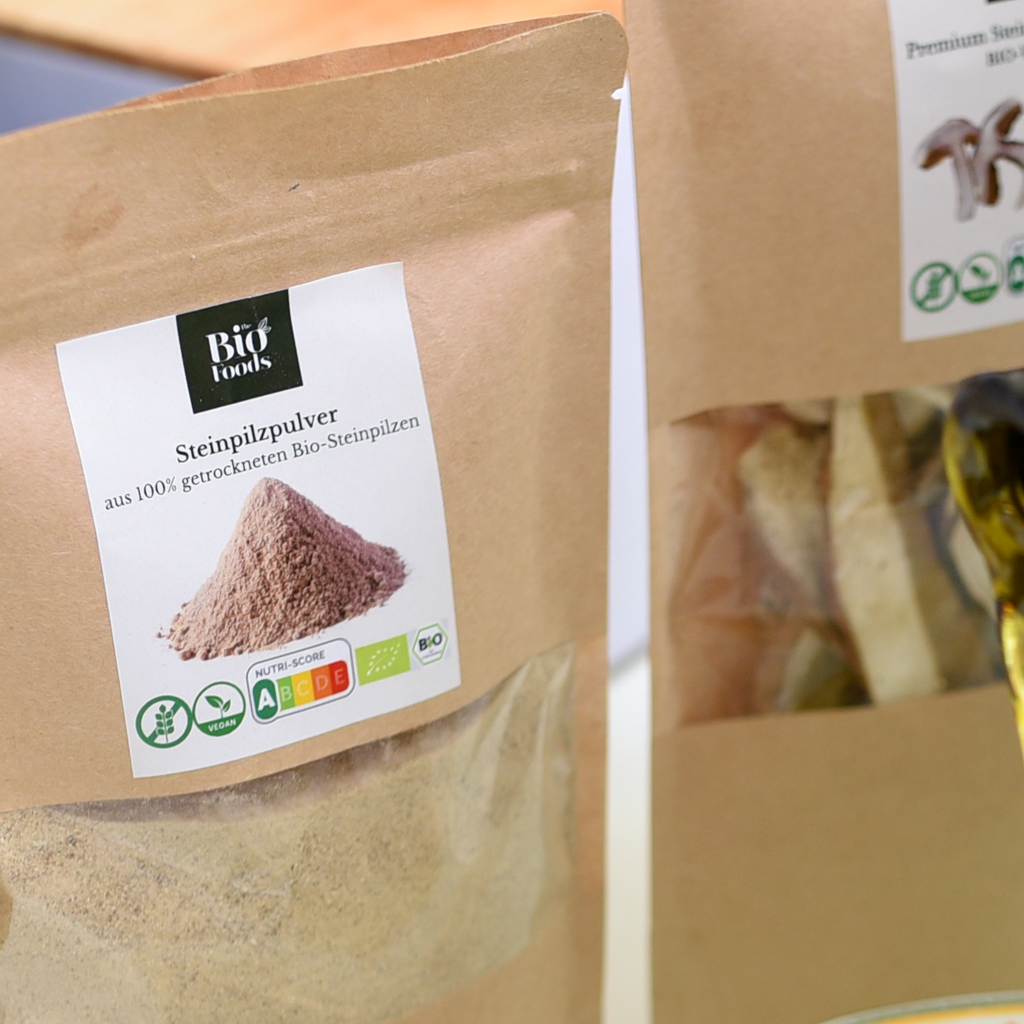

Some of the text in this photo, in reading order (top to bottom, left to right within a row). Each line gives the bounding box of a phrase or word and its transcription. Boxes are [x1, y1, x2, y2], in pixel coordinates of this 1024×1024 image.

[905, 32, 987, 60] Premium
[206, 325, 268, 364] Bio
[211, 353, 273, 383] Foods
[175, 407, 339, 464] Steinpilzpulver
[104, 415, 420, 510] aus 100% getrockneten Bio-Steinpilzen
[255, 650, 326, 678] NUTRI-SCORE
[258, 688, 276, 712] A
[208, 718, 237, 733] VEGAN
